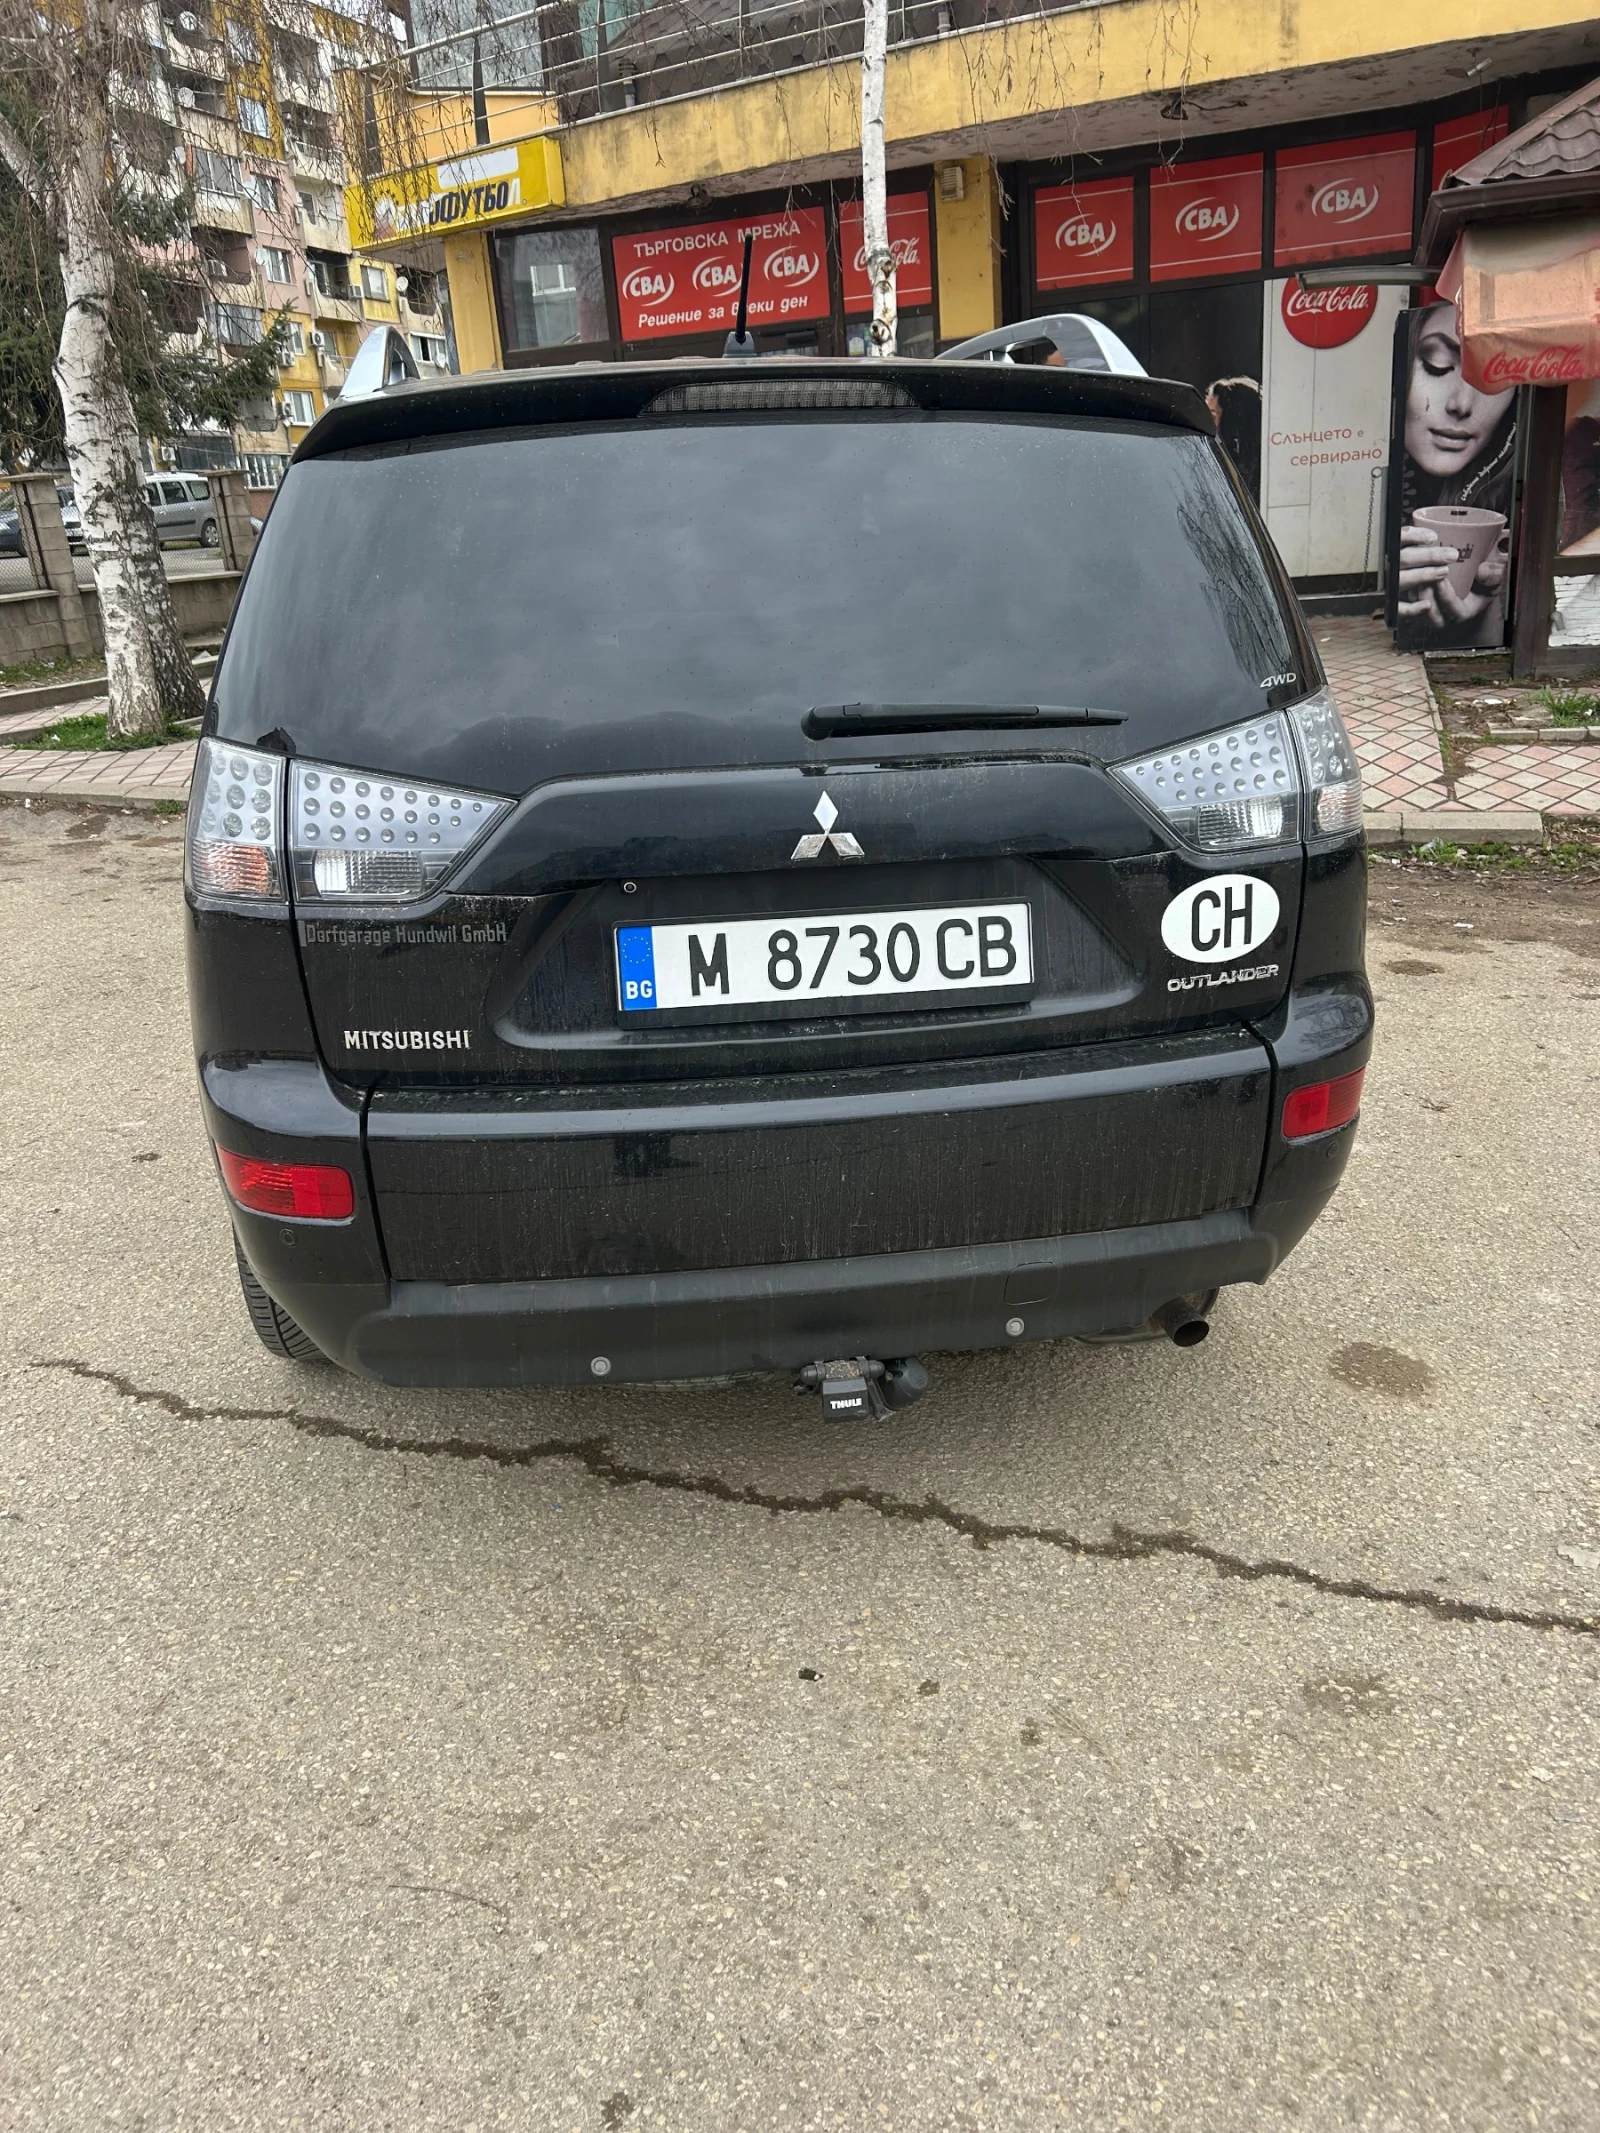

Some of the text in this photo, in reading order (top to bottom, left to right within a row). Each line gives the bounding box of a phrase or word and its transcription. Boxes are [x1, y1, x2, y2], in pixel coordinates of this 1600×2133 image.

[1321, 187, 1367, 212] CBA
[1184, 205, 1228, 231] CBA
[633, 220, 800, 258] ТЪРГОВСКА МРЕЖА
[1064, 222, 1106, 247] CBA
[700, 264, 737, 288] CBA
[771, 254, 810, 278] CBA
[630, 272, 665, 297] CBA
[638, 296, 808, 328] Решение за веки ден
[1286, 284, 1369, 316] Coca-Cola
[1483, 344, 1585, 384] Coca-Cola
[1270, 428, 1365, 446] Слънцето е
[1290, 448, 1383, 467] сервирано
[1260, 672, 1297, 688] 4WD
[1191, 883, 1253, 952] CH
[306, 922, 507, 946] Dorfgarage Hundwil GmbH
[688, 932, 730, 996] M
[625, 979, 654, 1000] BG
[1166, 964, 1279, 992] OUTLANDER
[343, 1030, 470, 1050] MITSUBISHI
[829, 1397, 862, 1410] THULE
